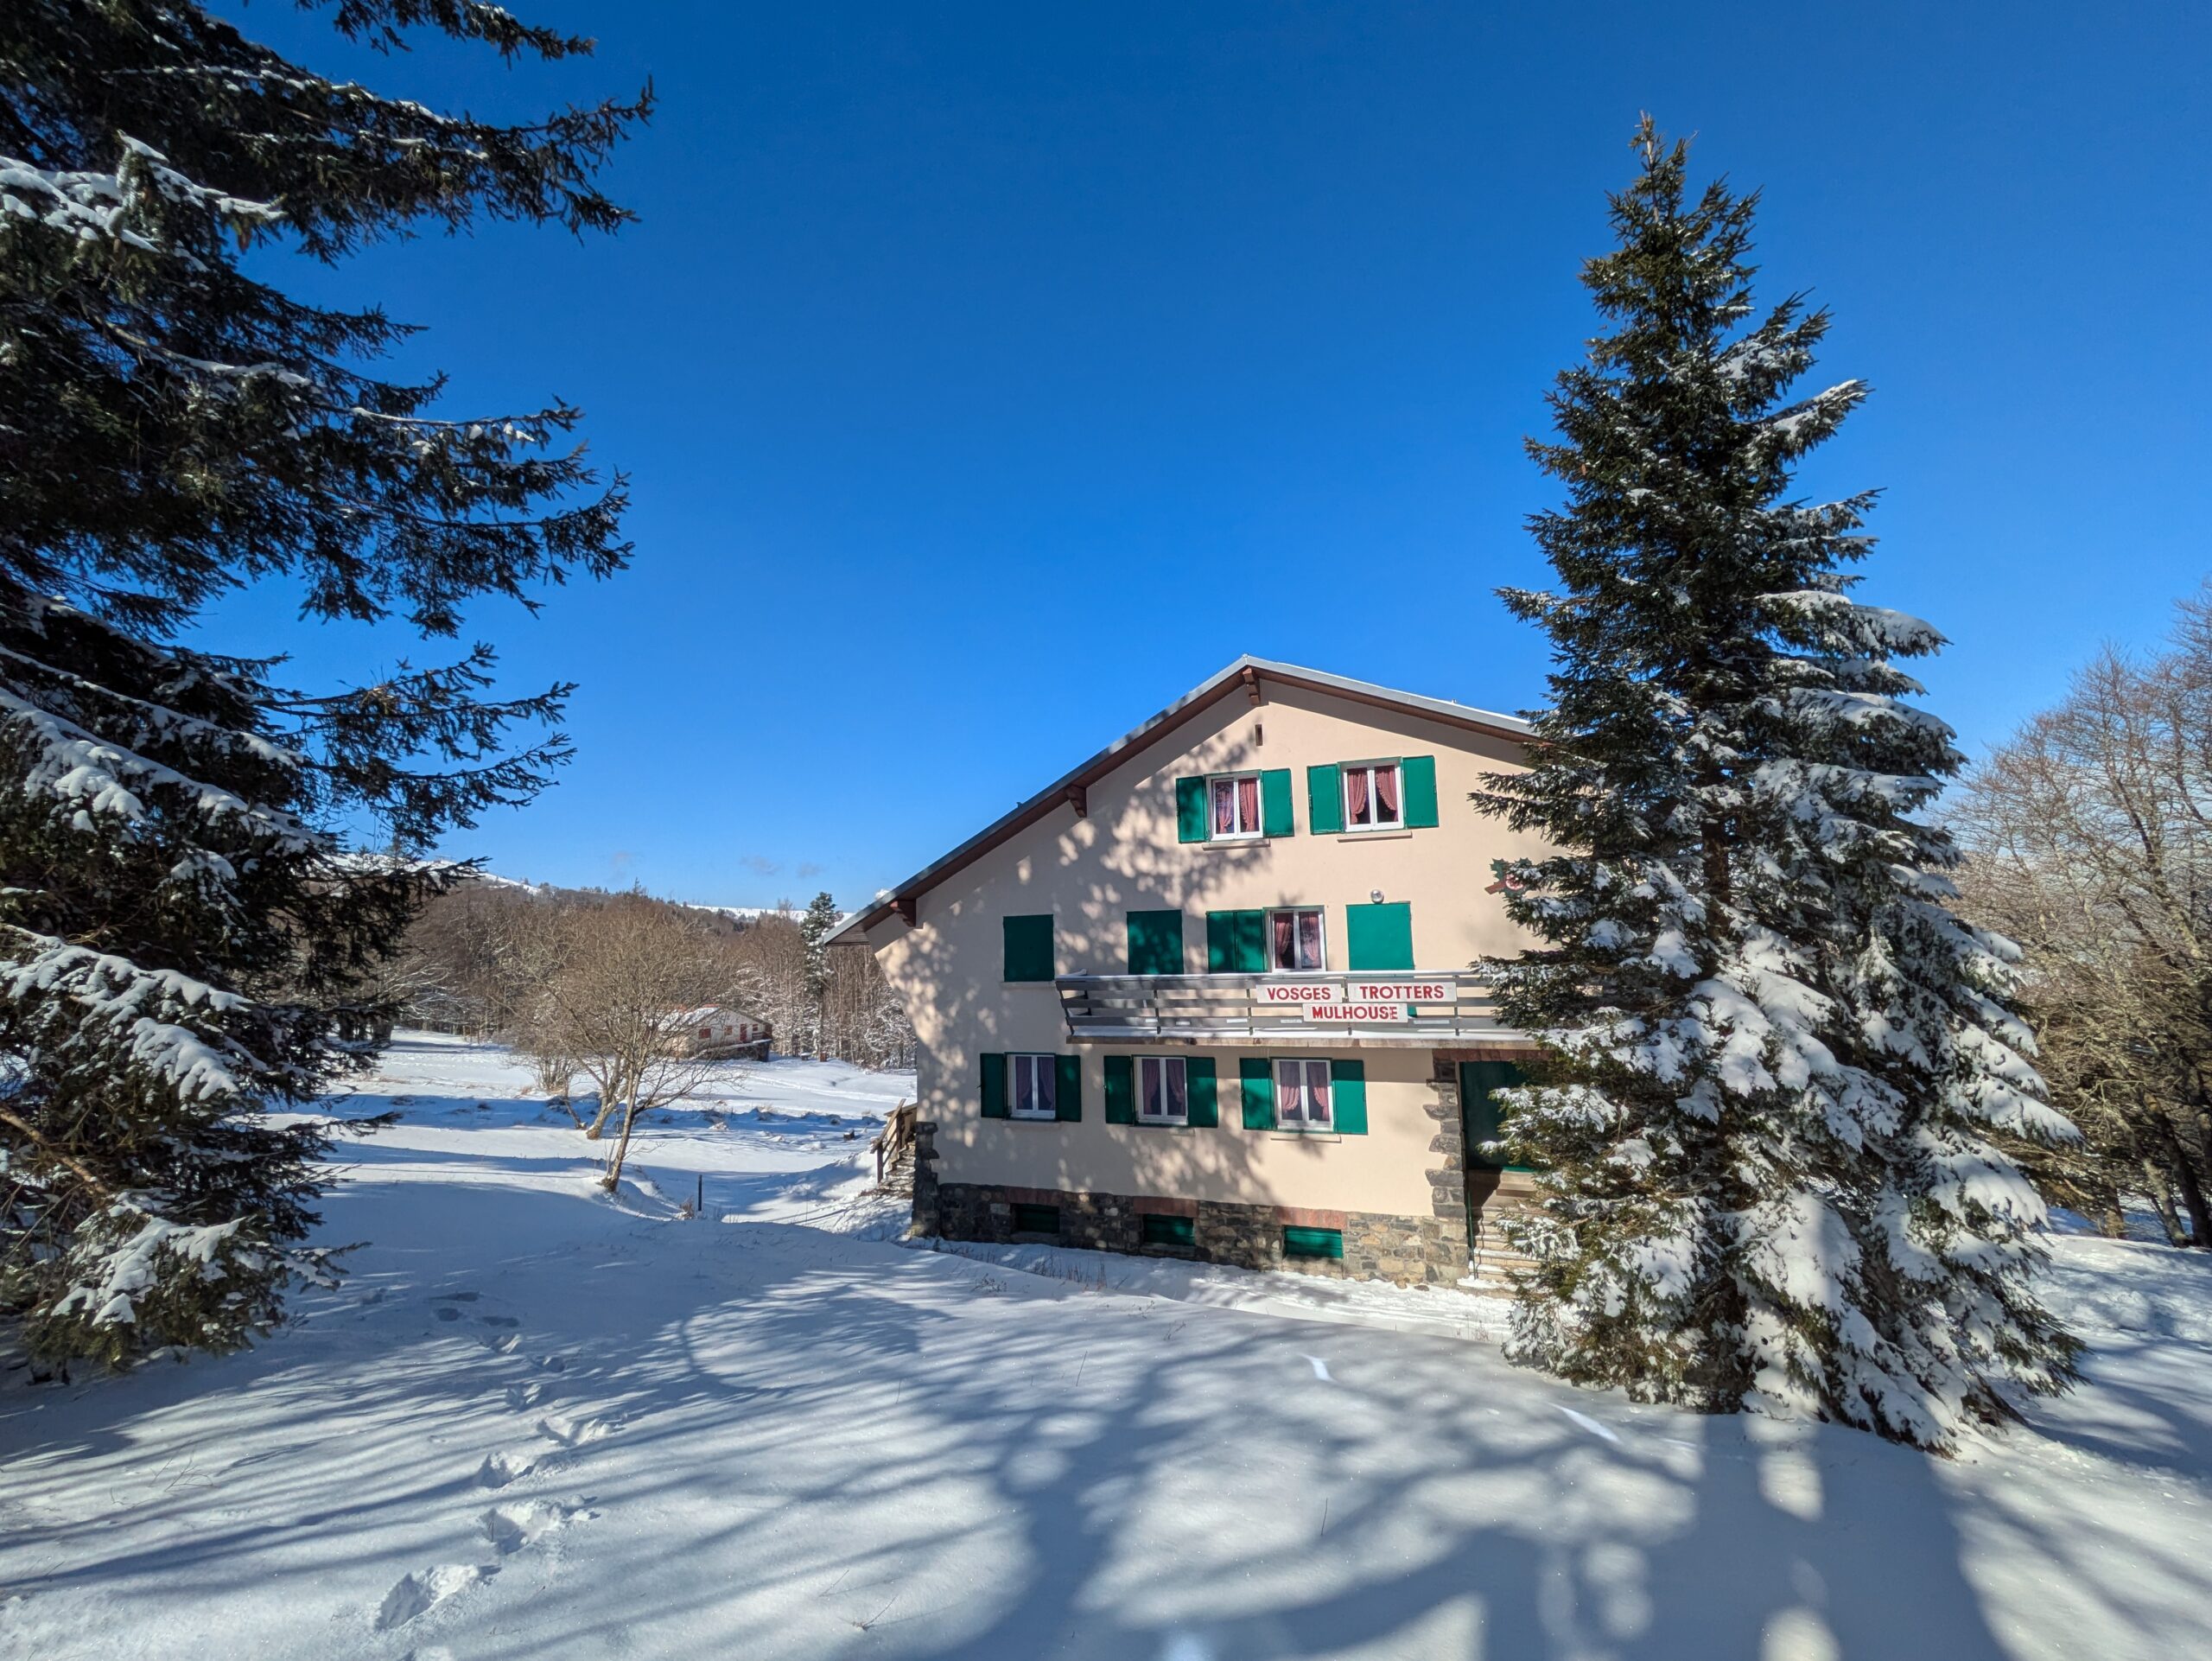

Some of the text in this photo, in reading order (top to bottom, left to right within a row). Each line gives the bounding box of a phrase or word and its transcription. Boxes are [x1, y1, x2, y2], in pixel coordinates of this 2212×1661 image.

[1267, 984, 1445, 1001] VOSGES TROTTERS
[1312, 1005, 1398, 1021] MULHOUSE
